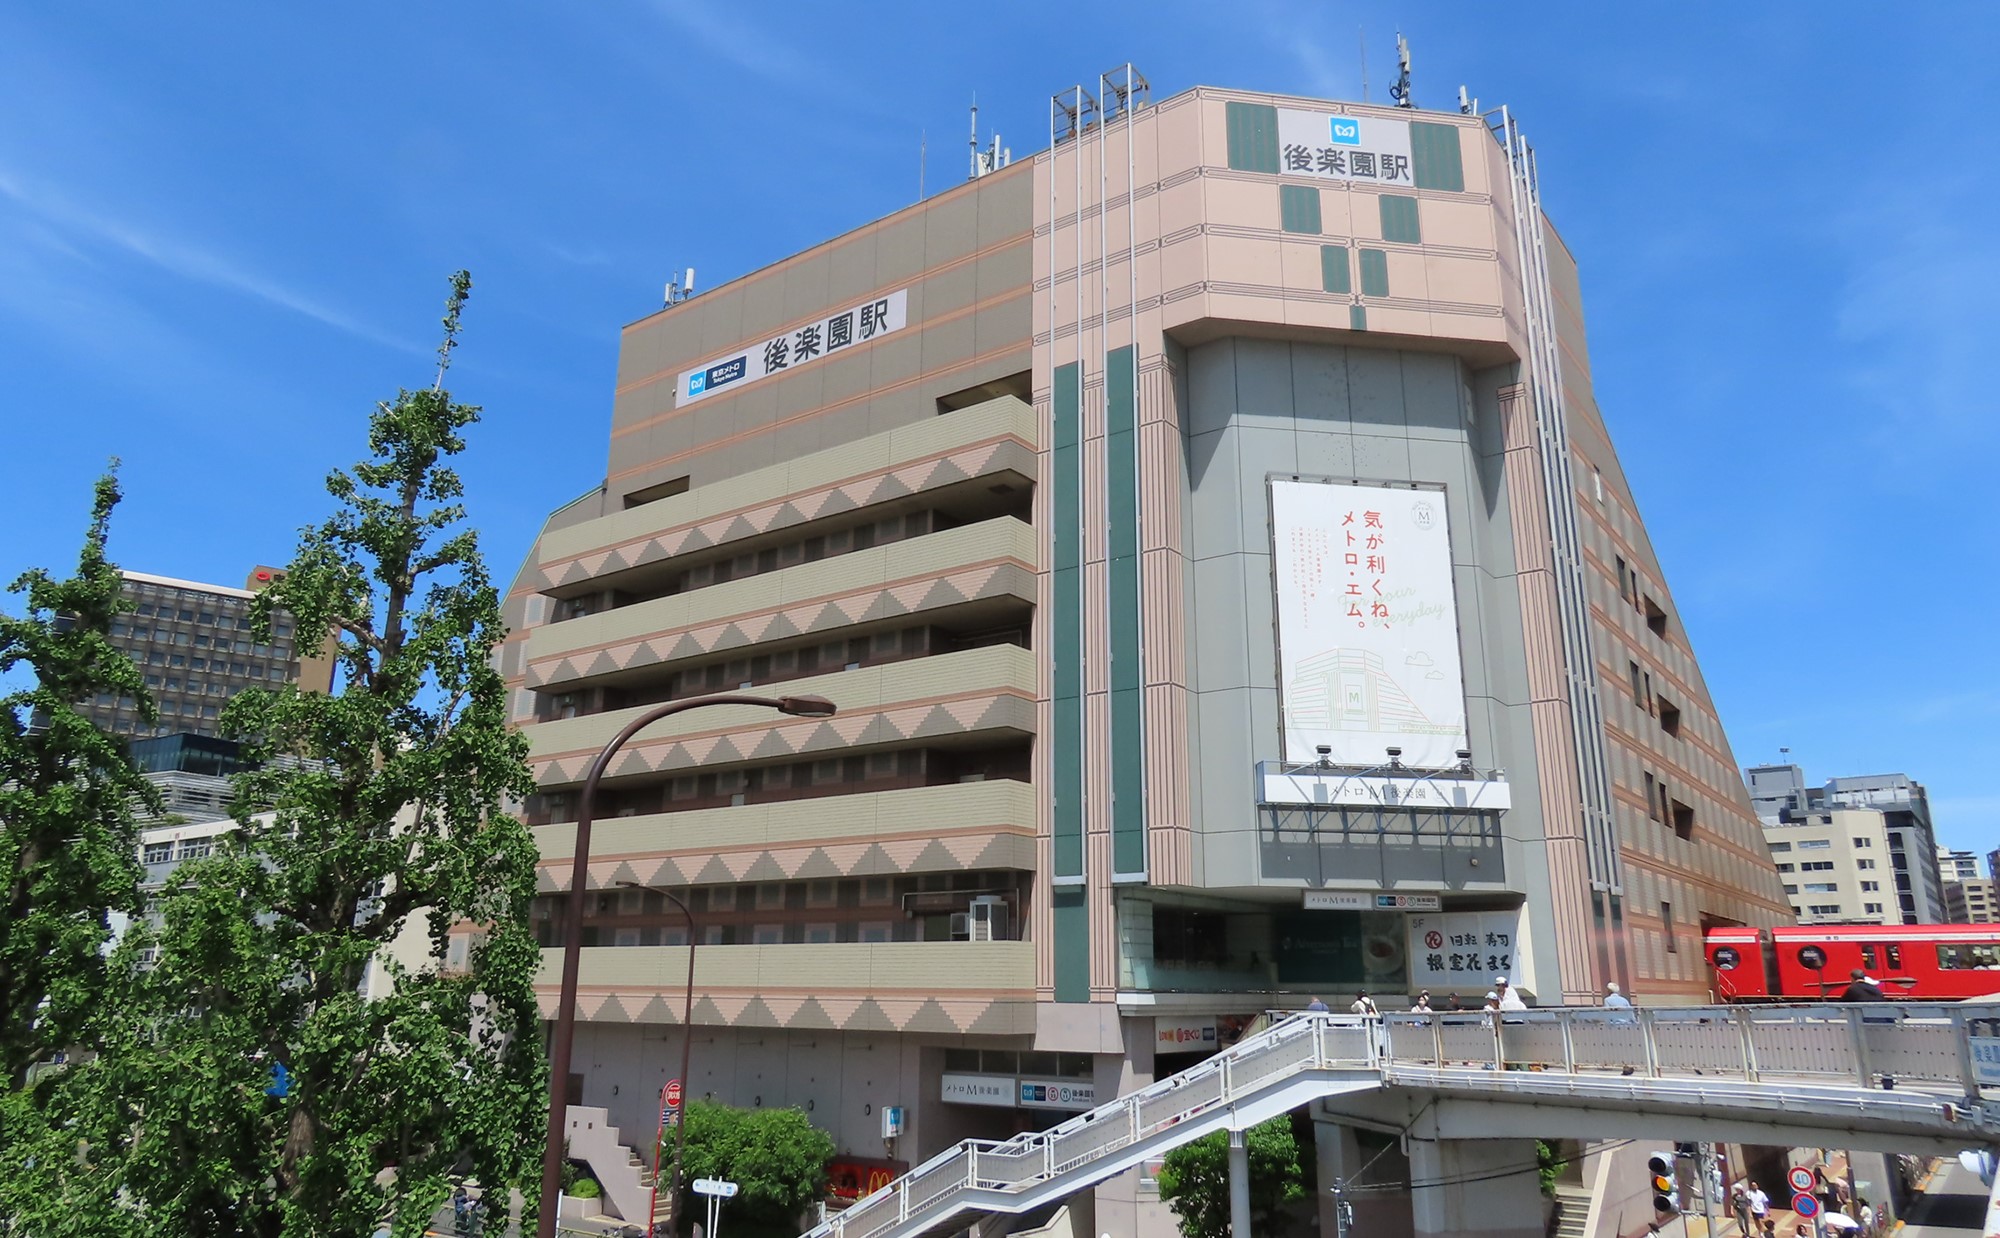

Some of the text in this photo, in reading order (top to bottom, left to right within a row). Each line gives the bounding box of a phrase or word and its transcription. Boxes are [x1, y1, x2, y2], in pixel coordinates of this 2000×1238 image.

[1283, 143, 1410, 181] 後楽園駅
[763, 298, 889, 375] 後楽園駅
[1341, 510, 1366, 629] メトロ・エム。
[1363, 510, 1390, 630] 気が利くね、
[1412, 918, 1424, 929] 5F
[1795, 1173, 1809, 1185] 40
